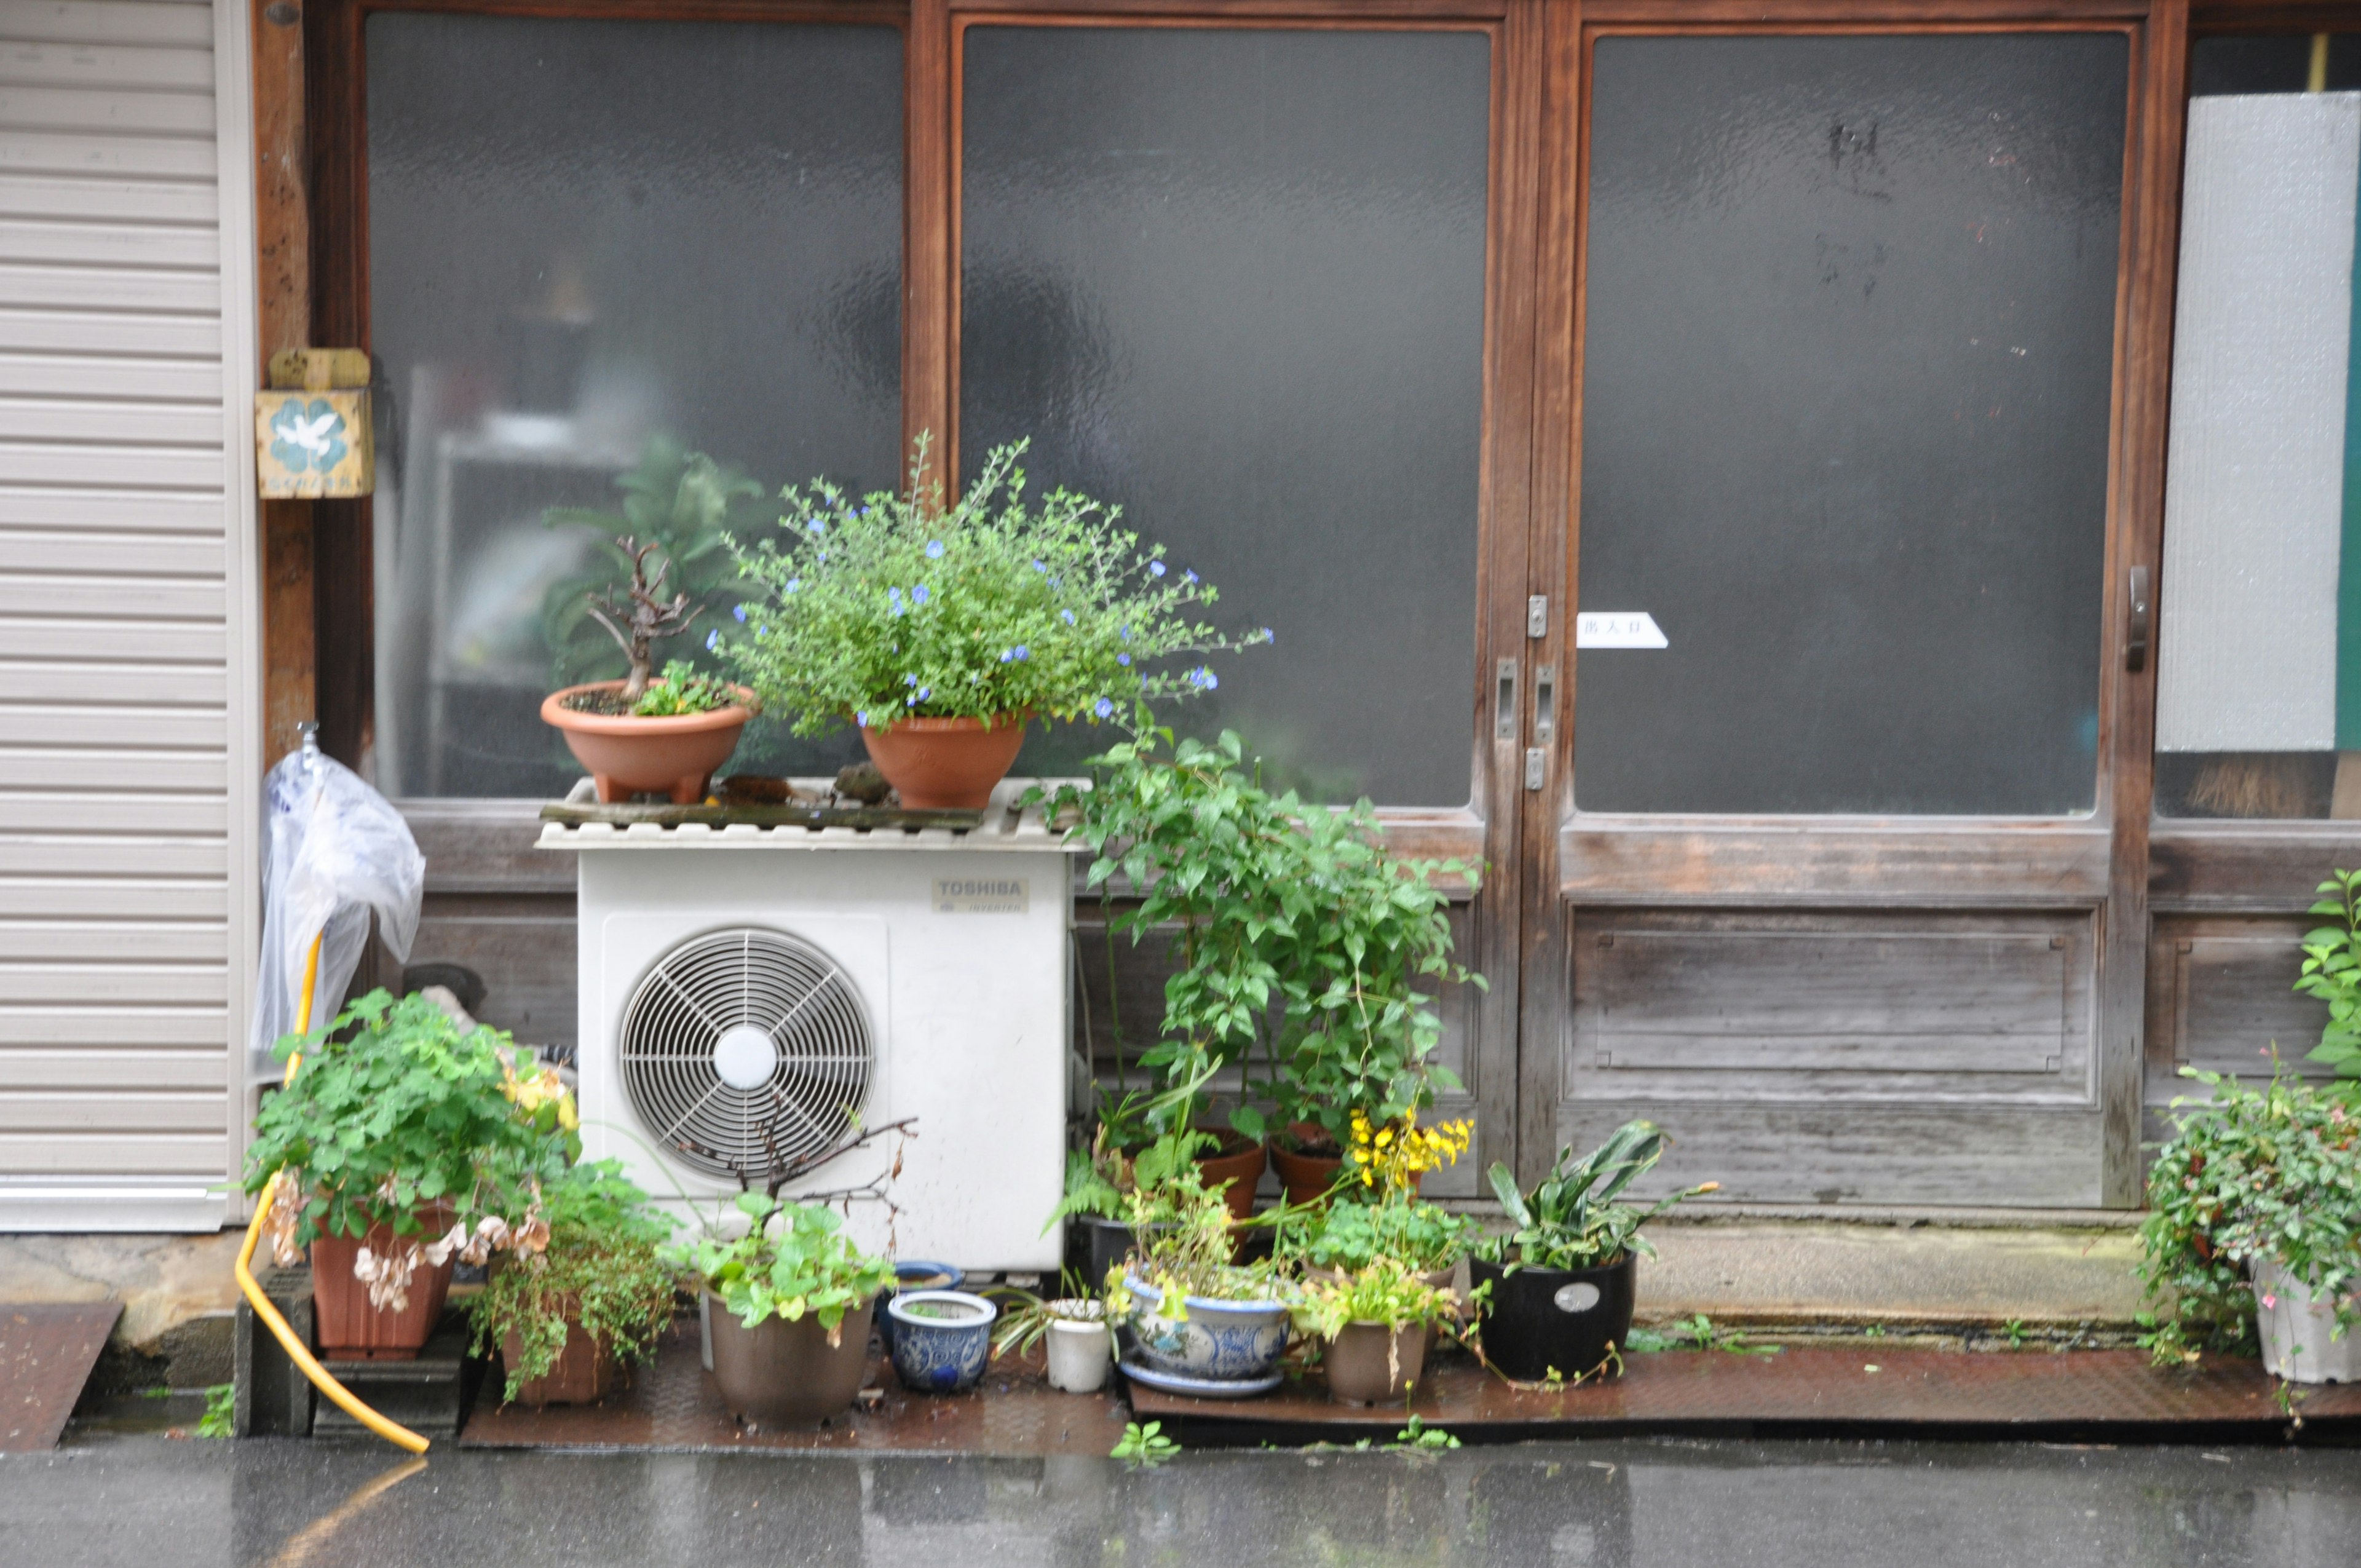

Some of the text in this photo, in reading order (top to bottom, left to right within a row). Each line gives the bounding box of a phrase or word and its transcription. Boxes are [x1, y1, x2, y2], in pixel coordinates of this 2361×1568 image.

[1584, 619, 1640, 635] 出入口
[939, 880, 1021, 897] TOSHIBA
